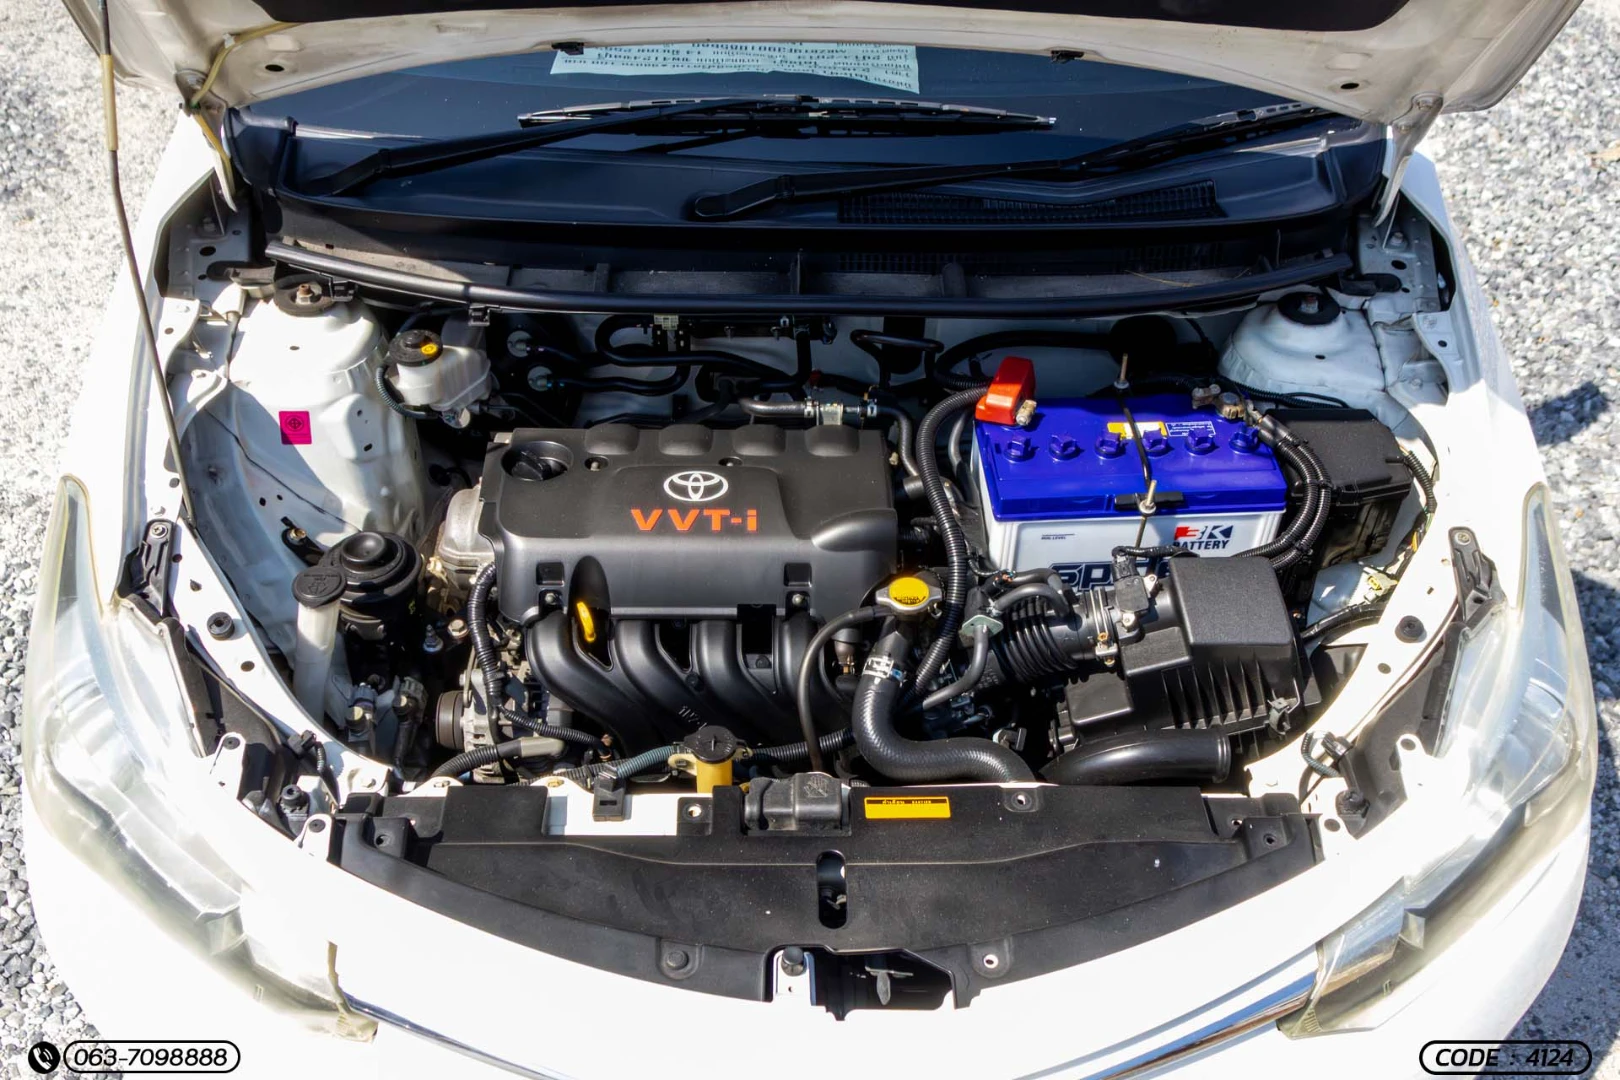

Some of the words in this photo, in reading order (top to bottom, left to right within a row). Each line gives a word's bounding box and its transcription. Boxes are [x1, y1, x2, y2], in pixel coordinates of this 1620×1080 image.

[630, 508, 758, 532] VVT-i
[1174, 524, 1234, 541] 3K
[1173, 540, 1230, 551] BATTERY
